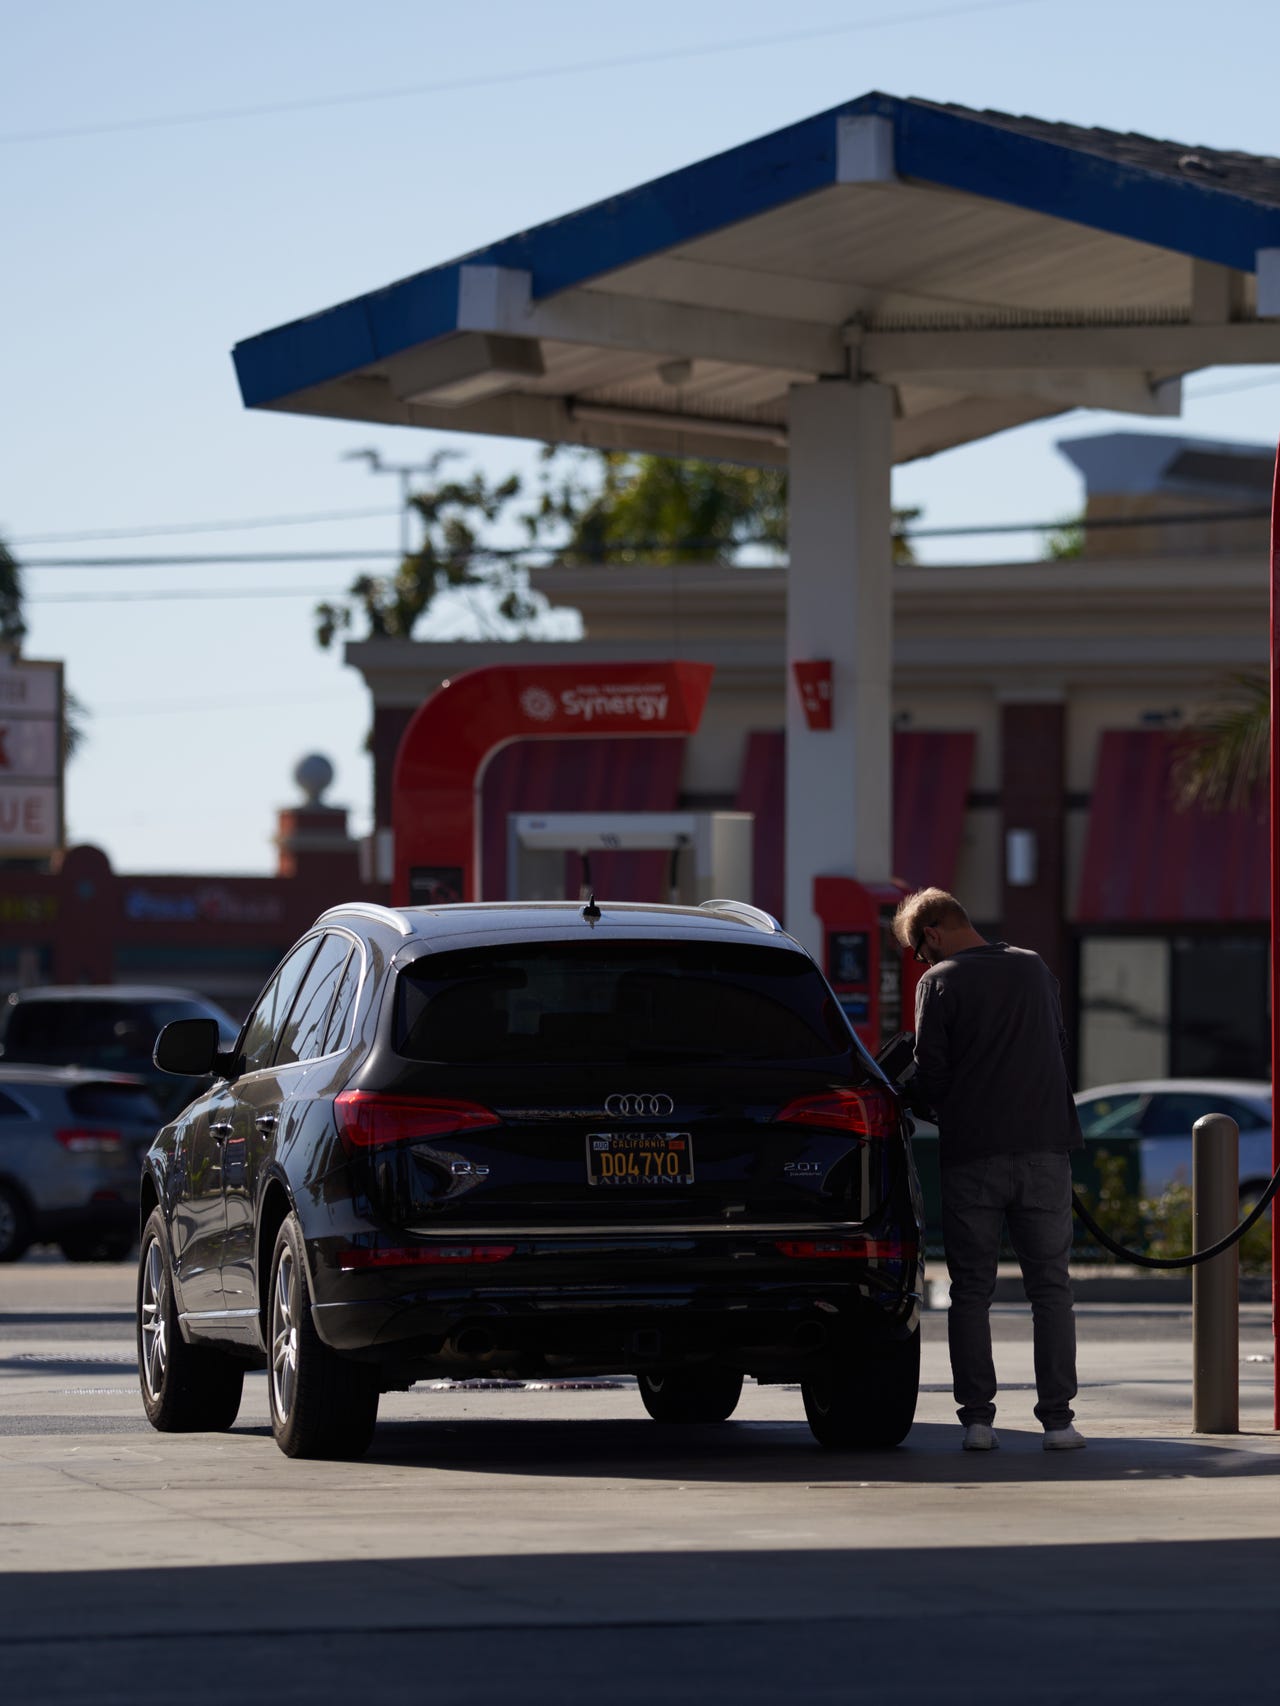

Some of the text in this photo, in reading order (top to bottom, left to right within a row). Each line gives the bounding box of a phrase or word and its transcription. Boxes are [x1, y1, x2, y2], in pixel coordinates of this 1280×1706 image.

[561, 688, 669, 721] Synergy
[612, 1140, 666, 1149] CALIFORNIA
[451, 1161, 490, 1175] Q5
